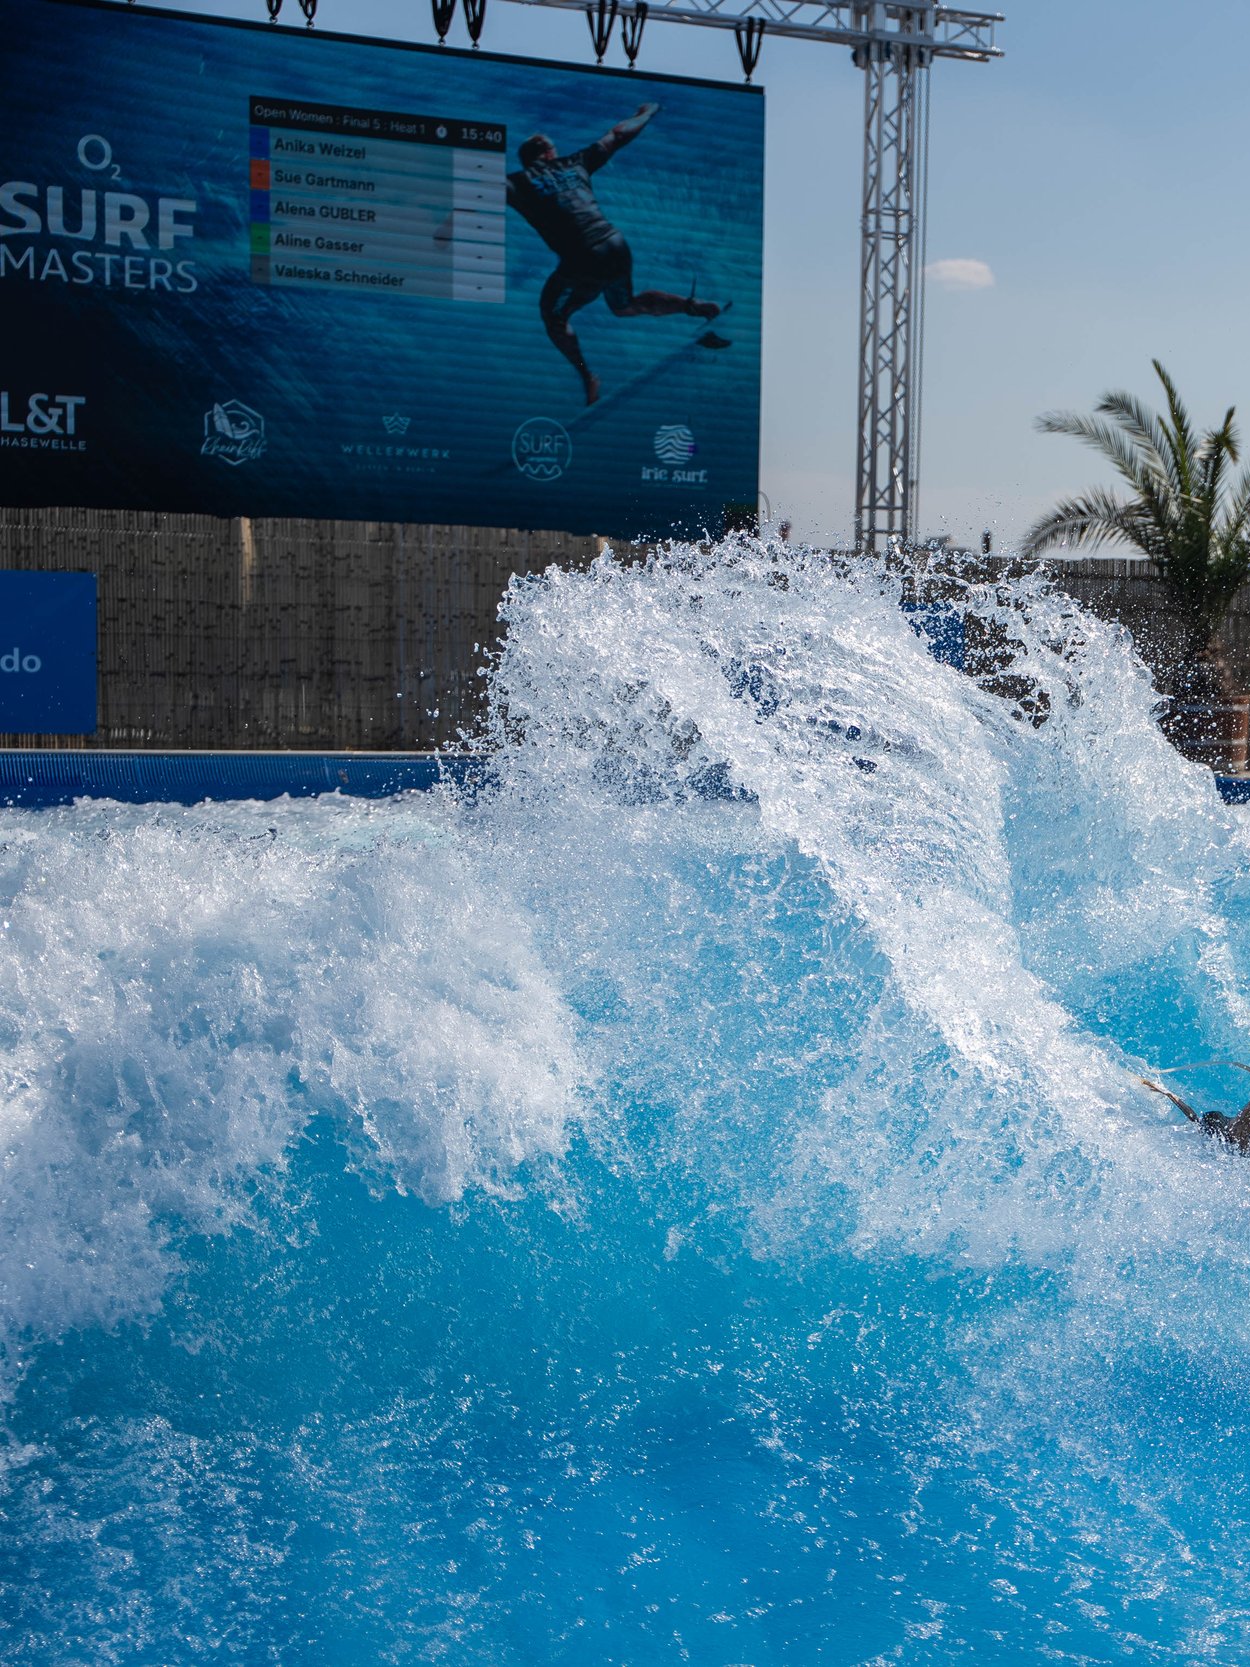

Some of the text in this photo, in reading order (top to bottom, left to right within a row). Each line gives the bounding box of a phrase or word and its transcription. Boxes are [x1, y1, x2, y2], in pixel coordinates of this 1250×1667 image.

[254, 105, 287, 119] Open
[289, 110, 333, 124] Women
[342, 115, 370, 129] Final
[372, 119, 381, 130] 5
[390, 121, 417, 134] Heat
[419, 124, 425, 134] 1
[274, 138, 315, 154] Anika
[461, 127, 503, 143] 15:40
[274, 170, 375, 192] Sue Gartmann
[0, 181, 197, 250] SURF
[274, 201, 377, 223] Alena GUBLER
[275, 233, 364, 253] Aline Gasser
[0, 243, 198, 293] MASTERS
[274, 264, 405, 287] Valeska Schneider
[0, 390, 86, 435] L&T
[0, 436, 87, 451] HASEWELLE
[518, 432, 565, 455] SURF
